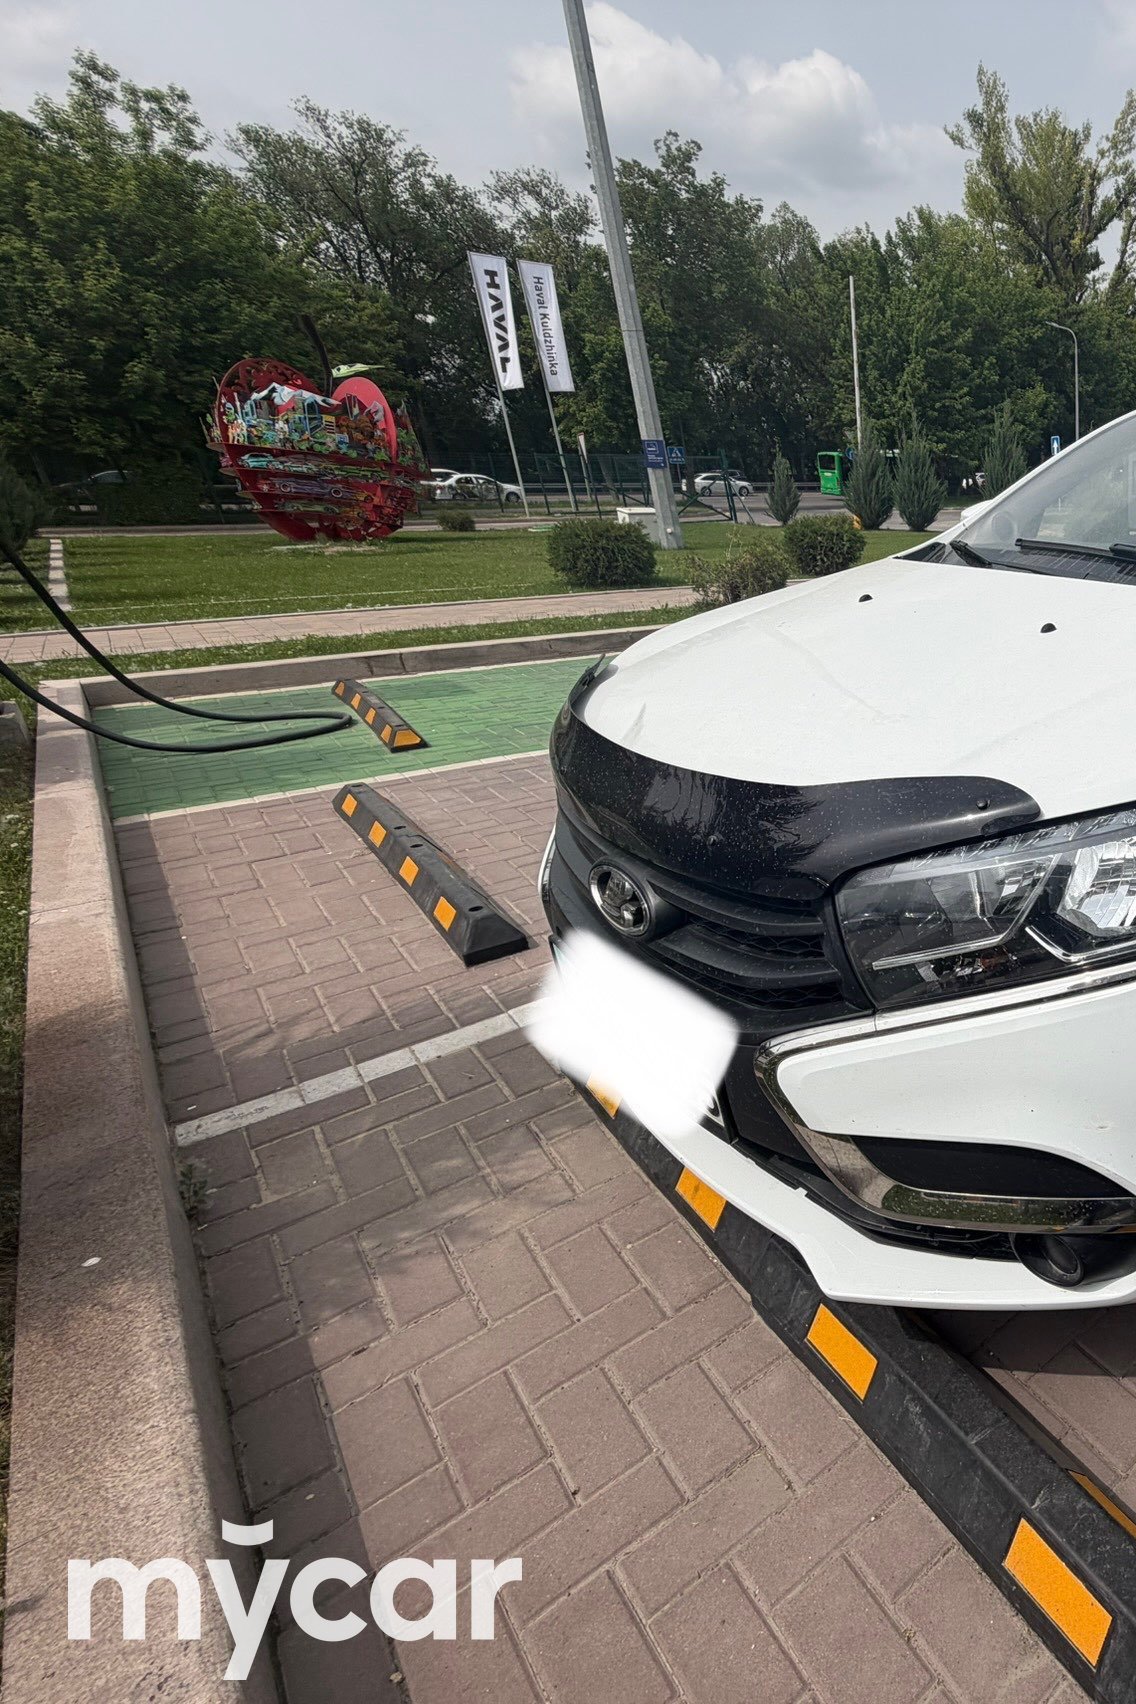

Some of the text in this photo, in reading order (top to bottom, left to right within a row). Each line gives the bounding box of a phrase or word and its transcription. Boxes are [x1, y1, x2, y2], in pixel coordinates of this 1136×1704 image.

[484, 269, 511, 373] HAVAL
[533, 276, 559, 376] Haval Kuldzhinka
